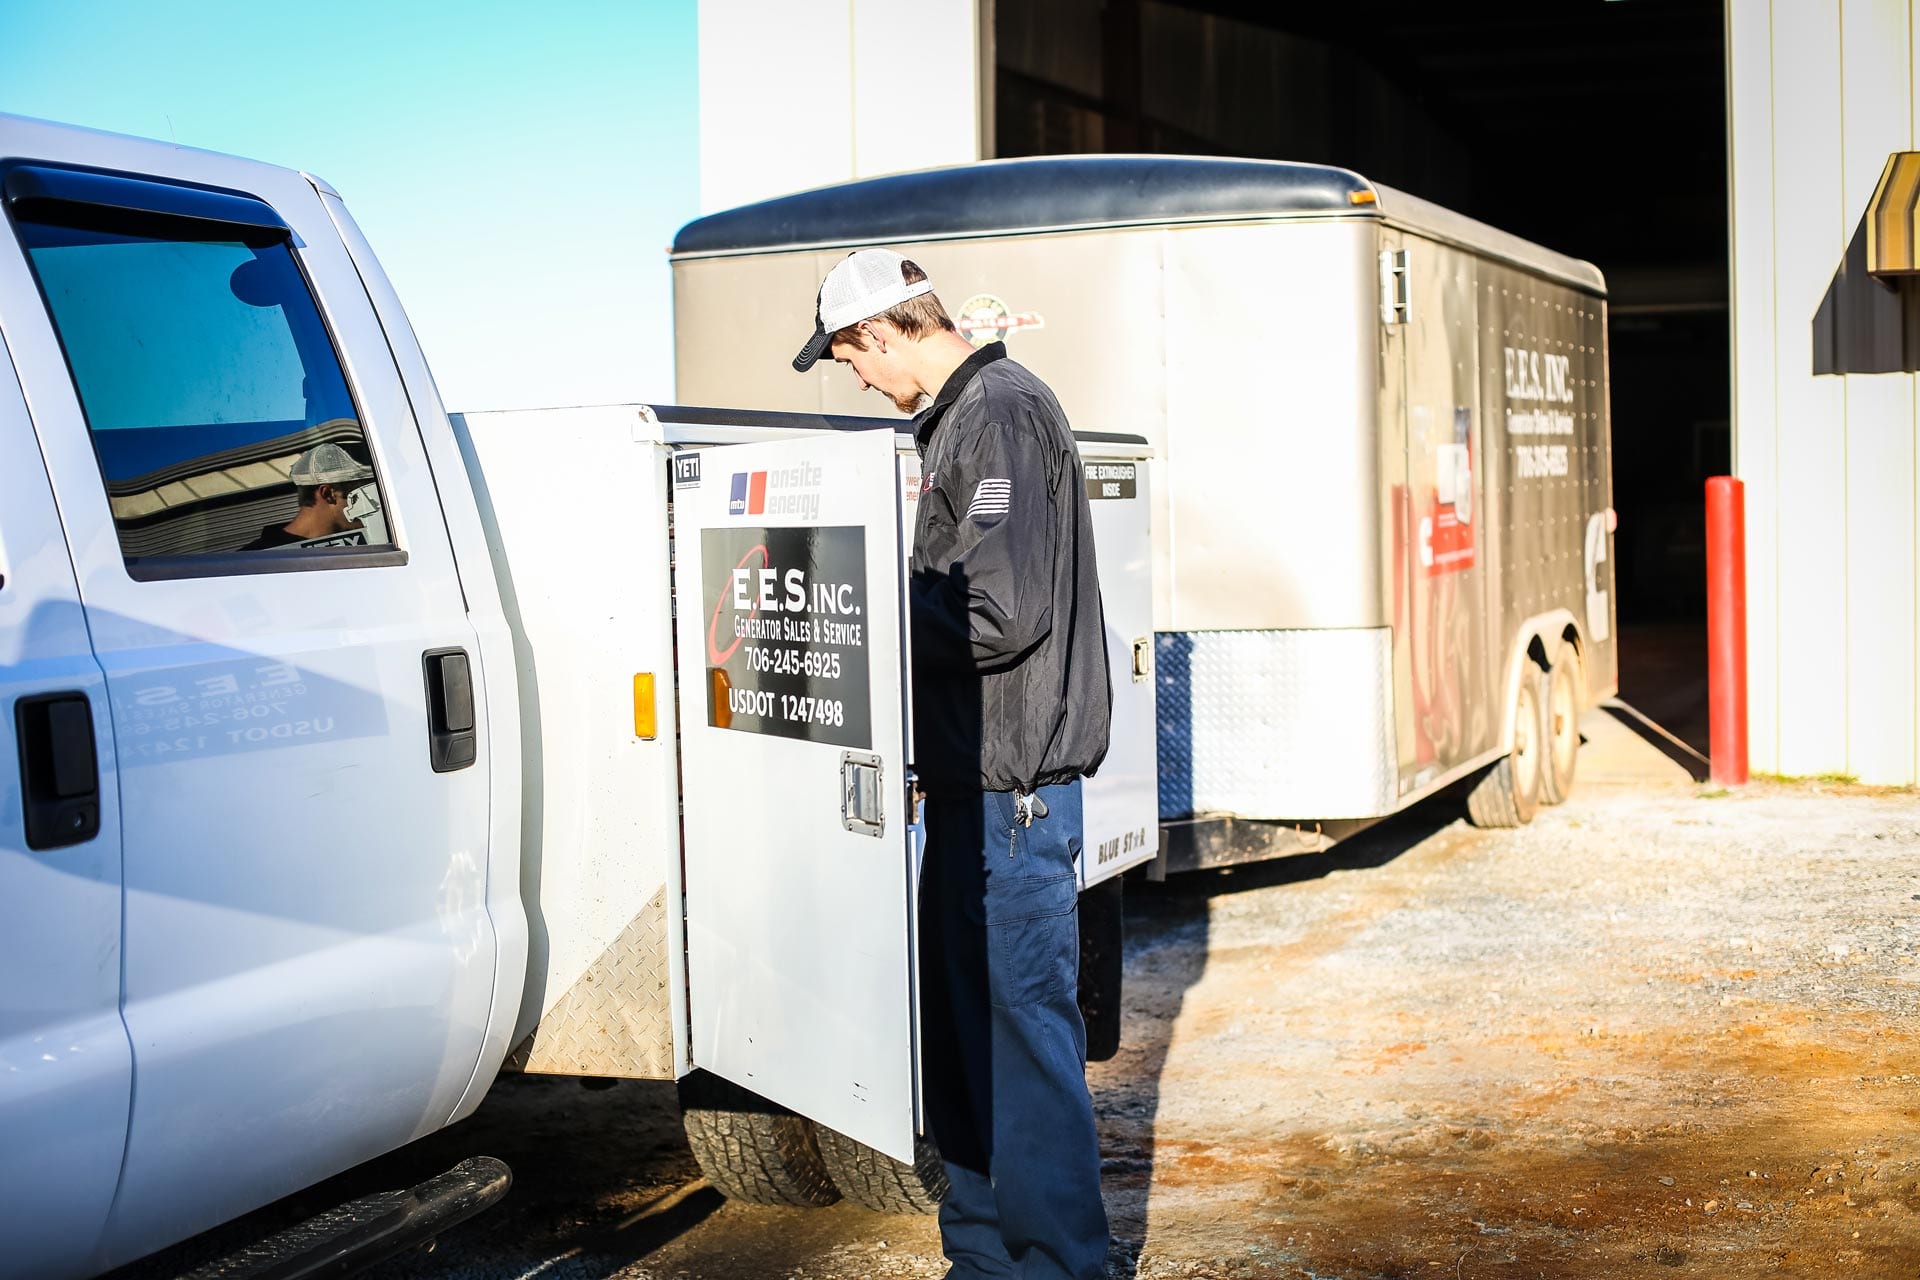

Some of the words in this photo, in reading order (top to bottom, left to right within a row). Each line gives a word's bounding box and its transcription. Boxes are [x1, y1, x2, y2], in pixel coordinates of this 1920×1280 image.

[676, 458, 699, 479] YETI
[770, 461, 822, 488] onsite
[768, 493, 820, 521] energy
[734, 615, 781, 641] GENERATOR
[784, 616, 810, 642] SALES
[813, 619, 820, 643] &
[823, 619, 862, 646] SERVICE
[744, 647, 841, 679] 706-245-6925
[728, 687, 775, 718] USDOT
[781, 694, 844, 727] 1247498
[1098, 836, 1120, 865] BLUE
